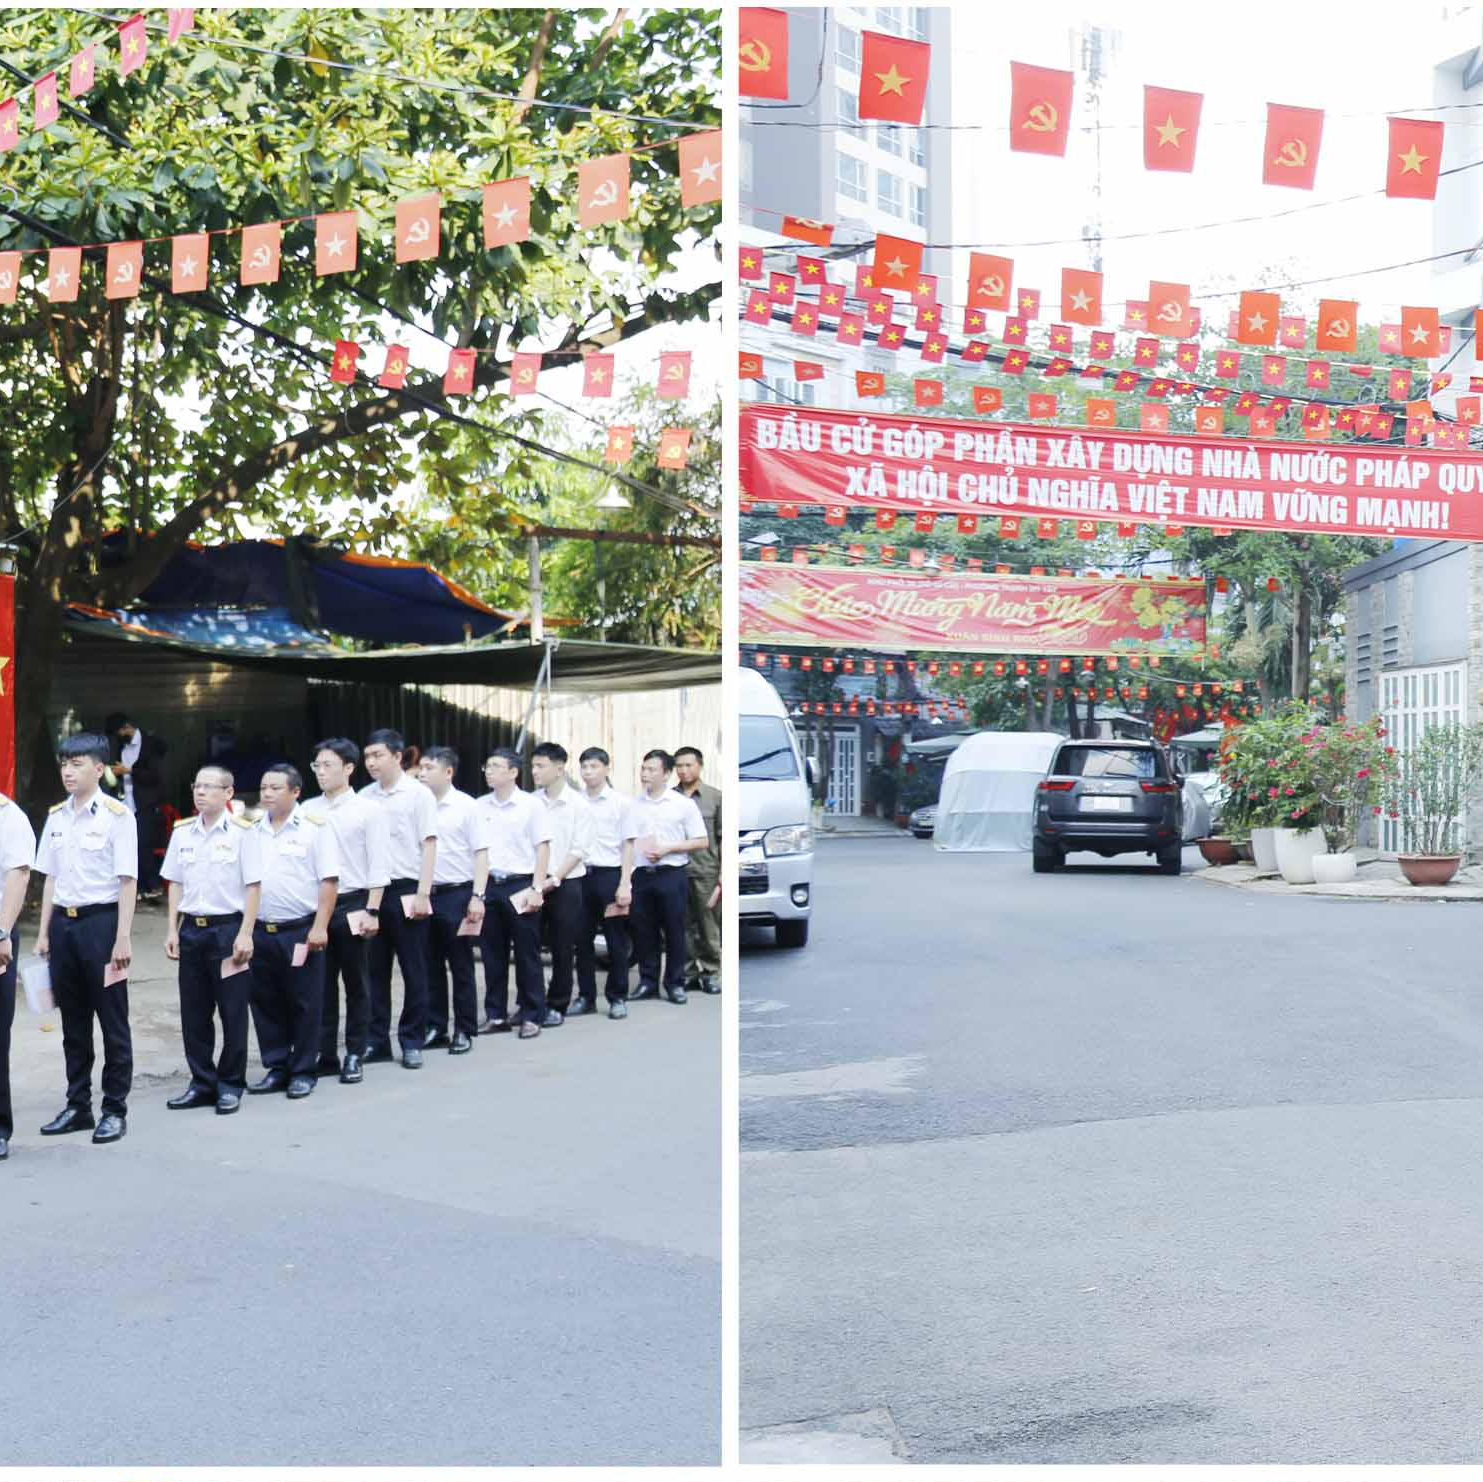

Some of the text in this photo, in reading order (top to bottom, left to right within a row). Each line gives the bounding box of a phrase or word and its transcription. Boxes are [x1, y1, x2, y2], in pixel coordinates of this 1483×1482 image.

[756, 412, 822, 453] BẦU
[830, 416, 877, 456] CỬ
[883, 423, 944, 459] GÓP
[953, 427, 1039, 467] PHẦN
[1046, 435, 1104, 470] XÂY
[1113, 442, 1193, 480] DỰNG
[1201, 445, 1262, 481] NHÀ
[1269, 450, 1347, 486] NƯỚC
[1355, 455, 1430, 490] PHÁP
[845, 462, 1450, 534] XÃ HỘI CHỦ NGHĨA VIỆT NAM VỮNG MẠNH!
